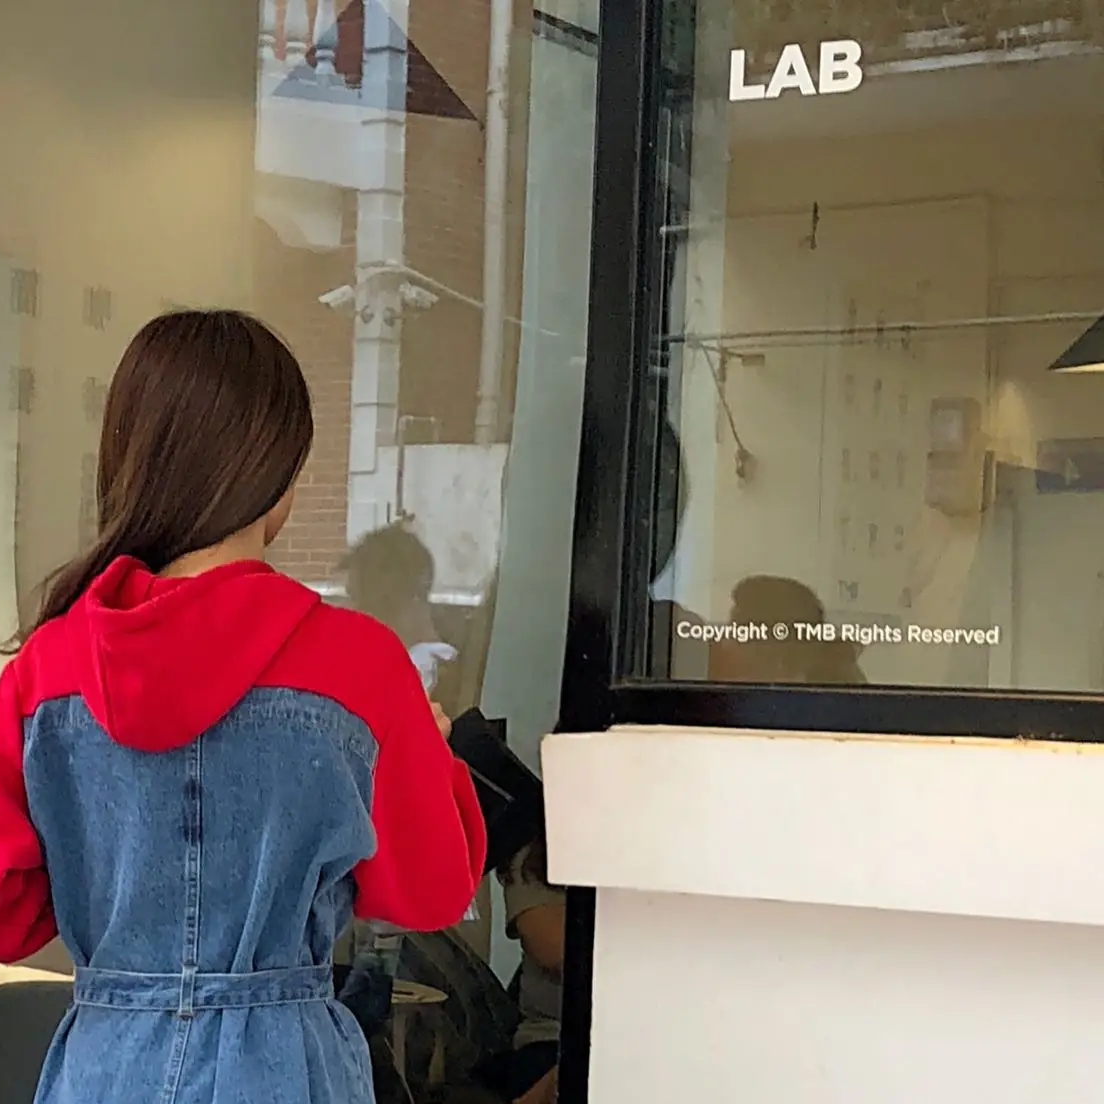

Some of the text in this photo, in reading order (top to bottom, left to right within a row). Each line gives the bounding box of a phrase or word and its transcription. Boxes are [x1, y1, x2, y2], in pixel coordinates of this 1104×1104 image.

[729, 40, 863, 101] LAB
[676, 621, 768, 643] Copyright
[794, 623, 836, 641] TMB
[841, 623, 902, 645] Rights
[907, 624, 1000, 645] Reserved
